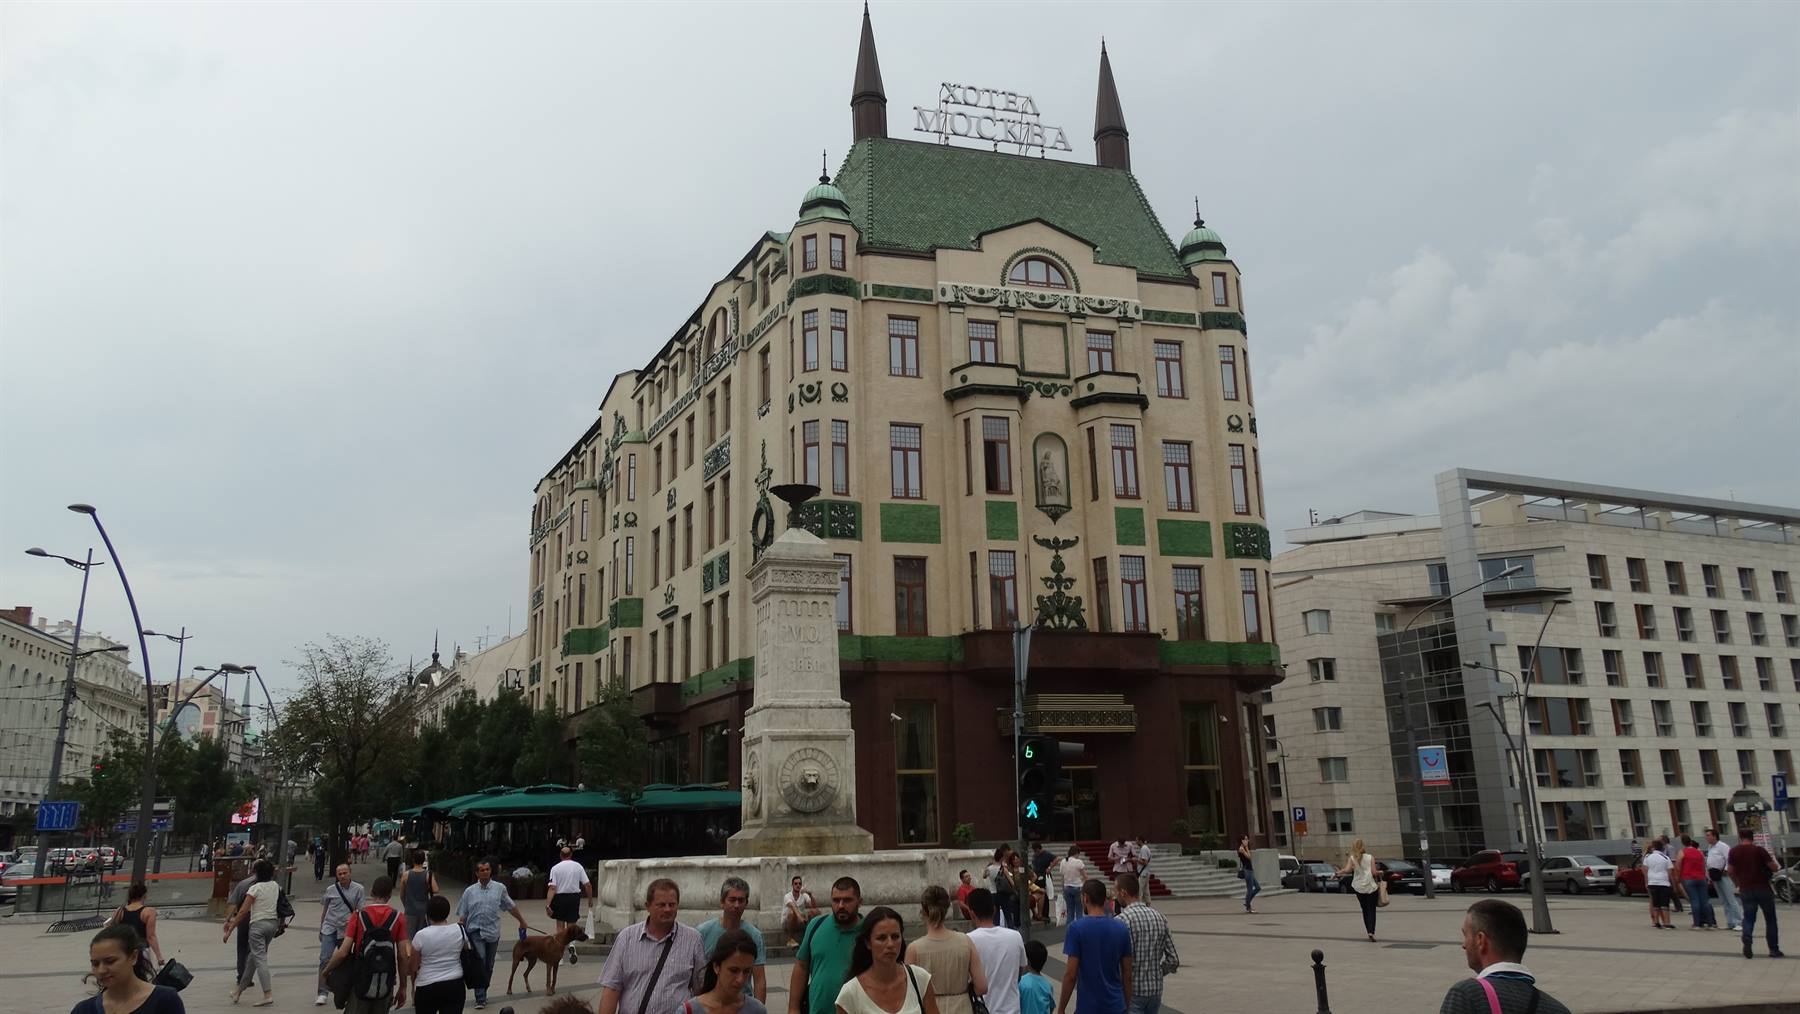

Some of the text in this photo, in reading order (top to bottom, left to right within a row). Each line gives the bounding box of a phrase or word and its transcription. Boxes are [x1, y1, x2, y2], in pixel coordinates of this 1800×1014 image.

[942, 83, 1040, 116] ХОТЕЛ
[913, 106, 1072, 151] МОСКВА
[1775, 777, 1784, 797] P
[1296, 808, 1303, 820] P
